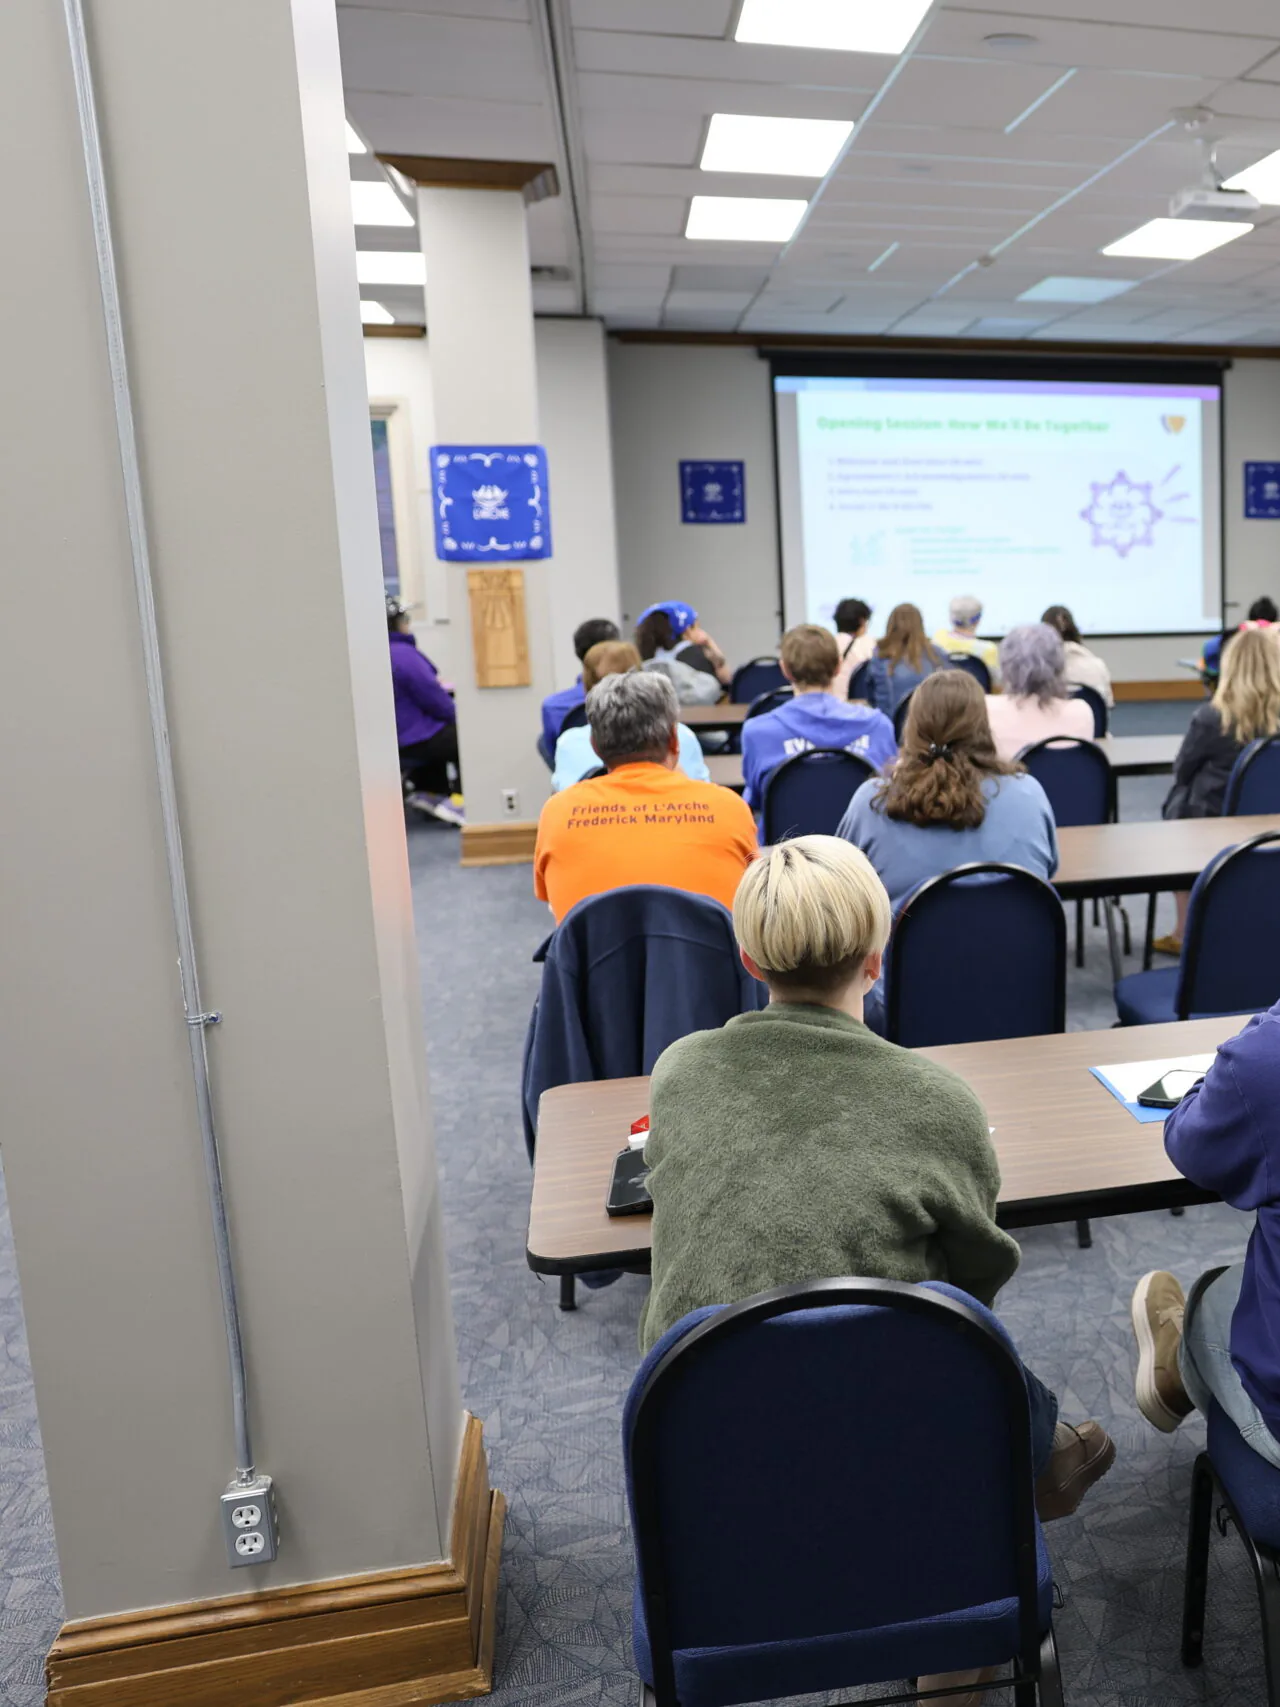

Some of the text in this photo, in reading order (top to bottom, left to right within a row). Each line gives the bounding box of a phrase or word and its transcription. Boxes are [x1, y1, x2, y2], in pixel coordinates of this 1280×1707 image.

[816, 415, 882, 432] Opening
[947, 418, 981, 430] How
[1044, 419, 1109, 434] Together
[571, 801, 710, 816] Friends of L'Arche
[567, 813, 716, 829] Frederick Maryland
